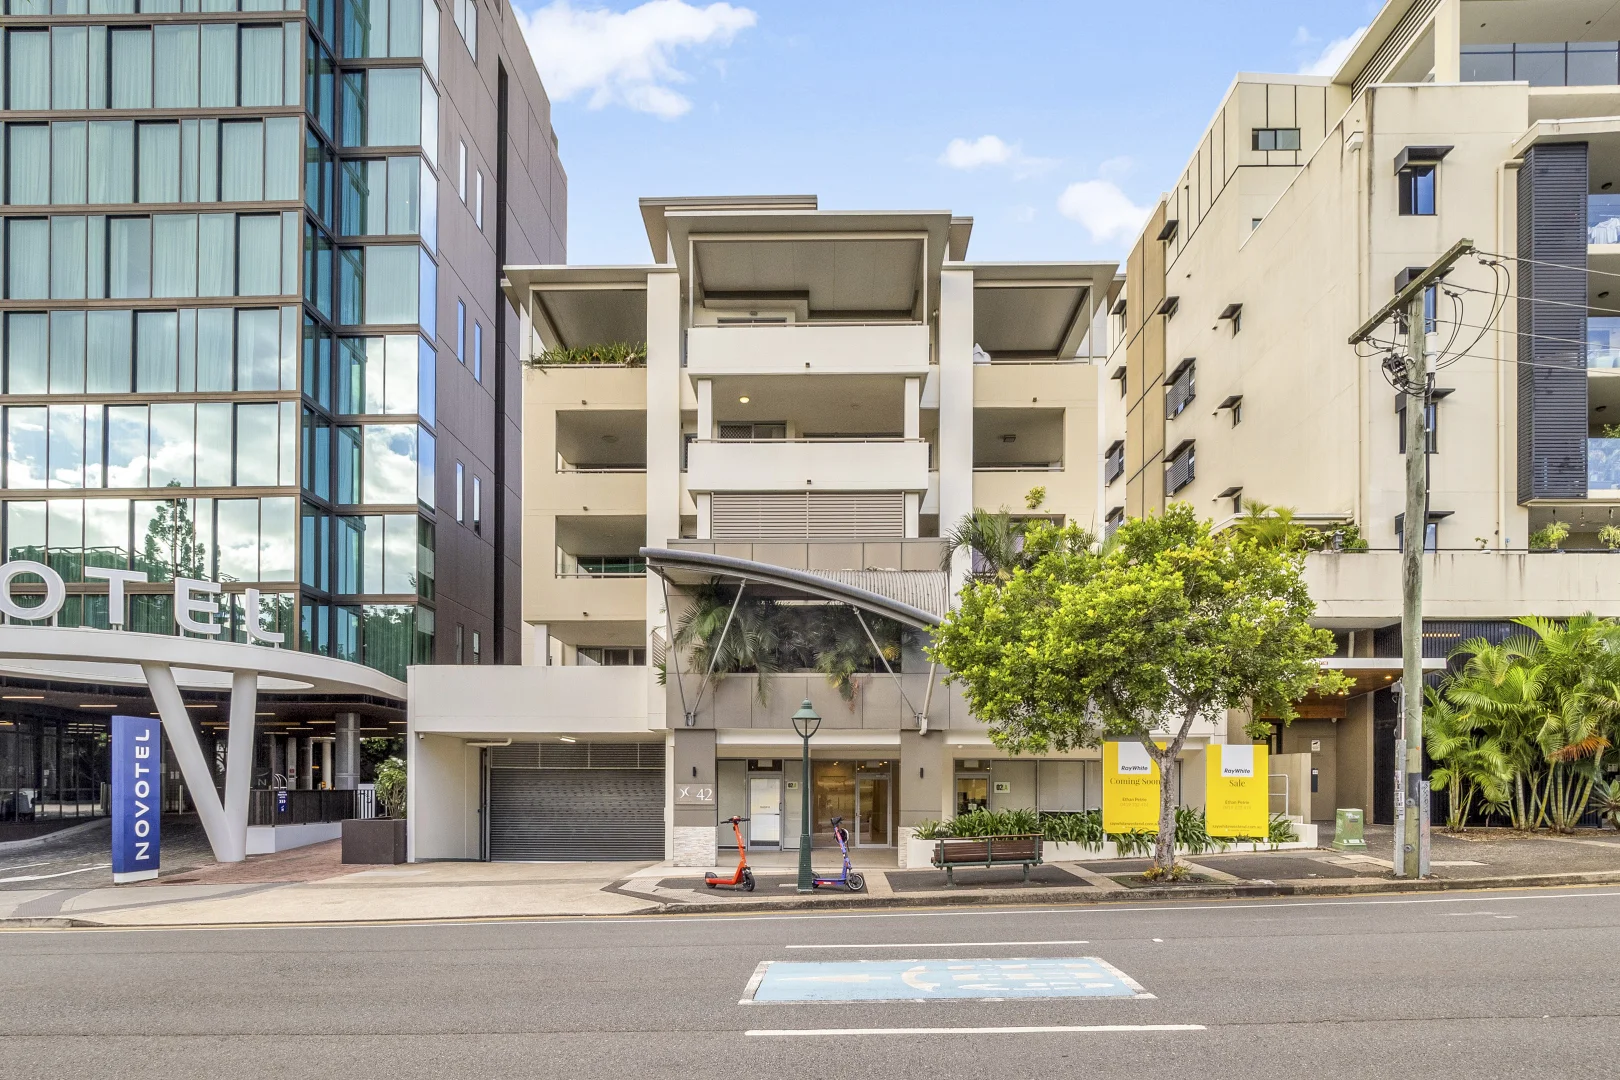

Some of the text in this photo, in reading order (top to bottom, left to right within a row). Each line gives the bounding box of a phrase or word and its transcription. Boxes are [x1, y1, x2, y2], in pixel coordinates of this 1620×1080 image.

[1110, 778, 1140, 786] Coming
[1229, 779, 1246, 787] Sale
[135, 729, 150, 861] NOVOTEL
[696, 788, 713, 801] 42
